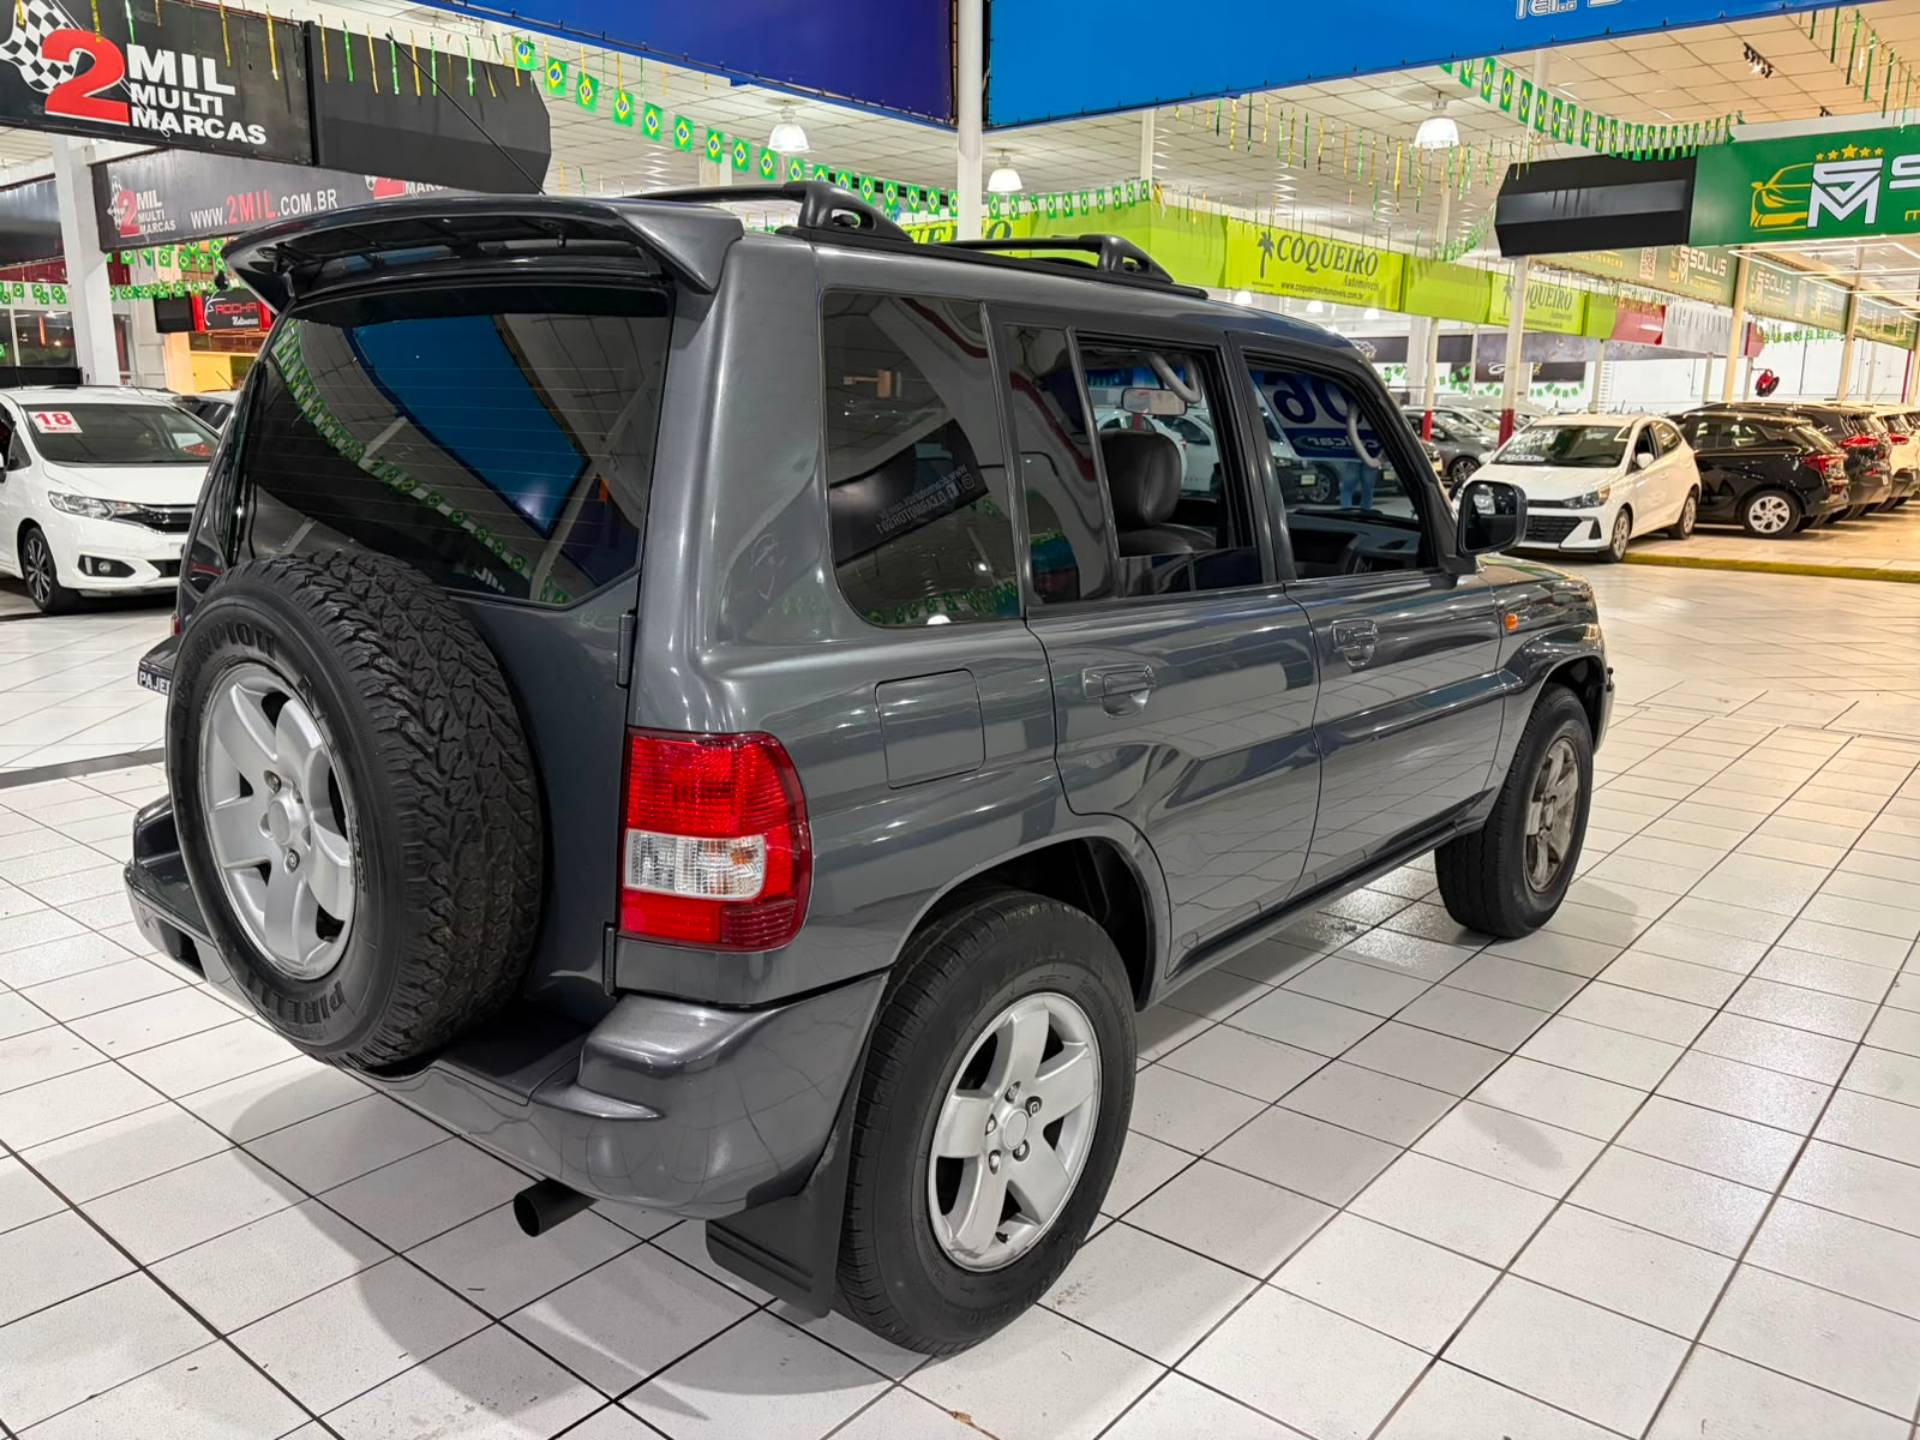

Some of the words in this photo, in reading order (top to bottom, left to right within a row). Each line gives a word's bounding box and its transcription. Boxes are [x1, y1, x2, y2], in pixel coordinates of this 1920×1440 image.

[42, 28, 130, 126] 2
[126, 43, 236, 96] MIL
[130, 82, 224, 116] MULTI
[131, 106, 267, 145] MARCAS
[118, 188, 141, 238] 2
[136, 190, 163, 211] MIL
[137, 210, 165, 224] MULTI
[190, 188, 339, 230] WWW.2MIL.COM.BR
[140, 220, 177, 234] MARCAS
[1276, 234, 1379, 277] COQUEIRO
[1690, 247, 1728, 277] SOLUS
[1526, 284, 1573, 311] QUEIRO
[35, 413, 73, 426] 18
